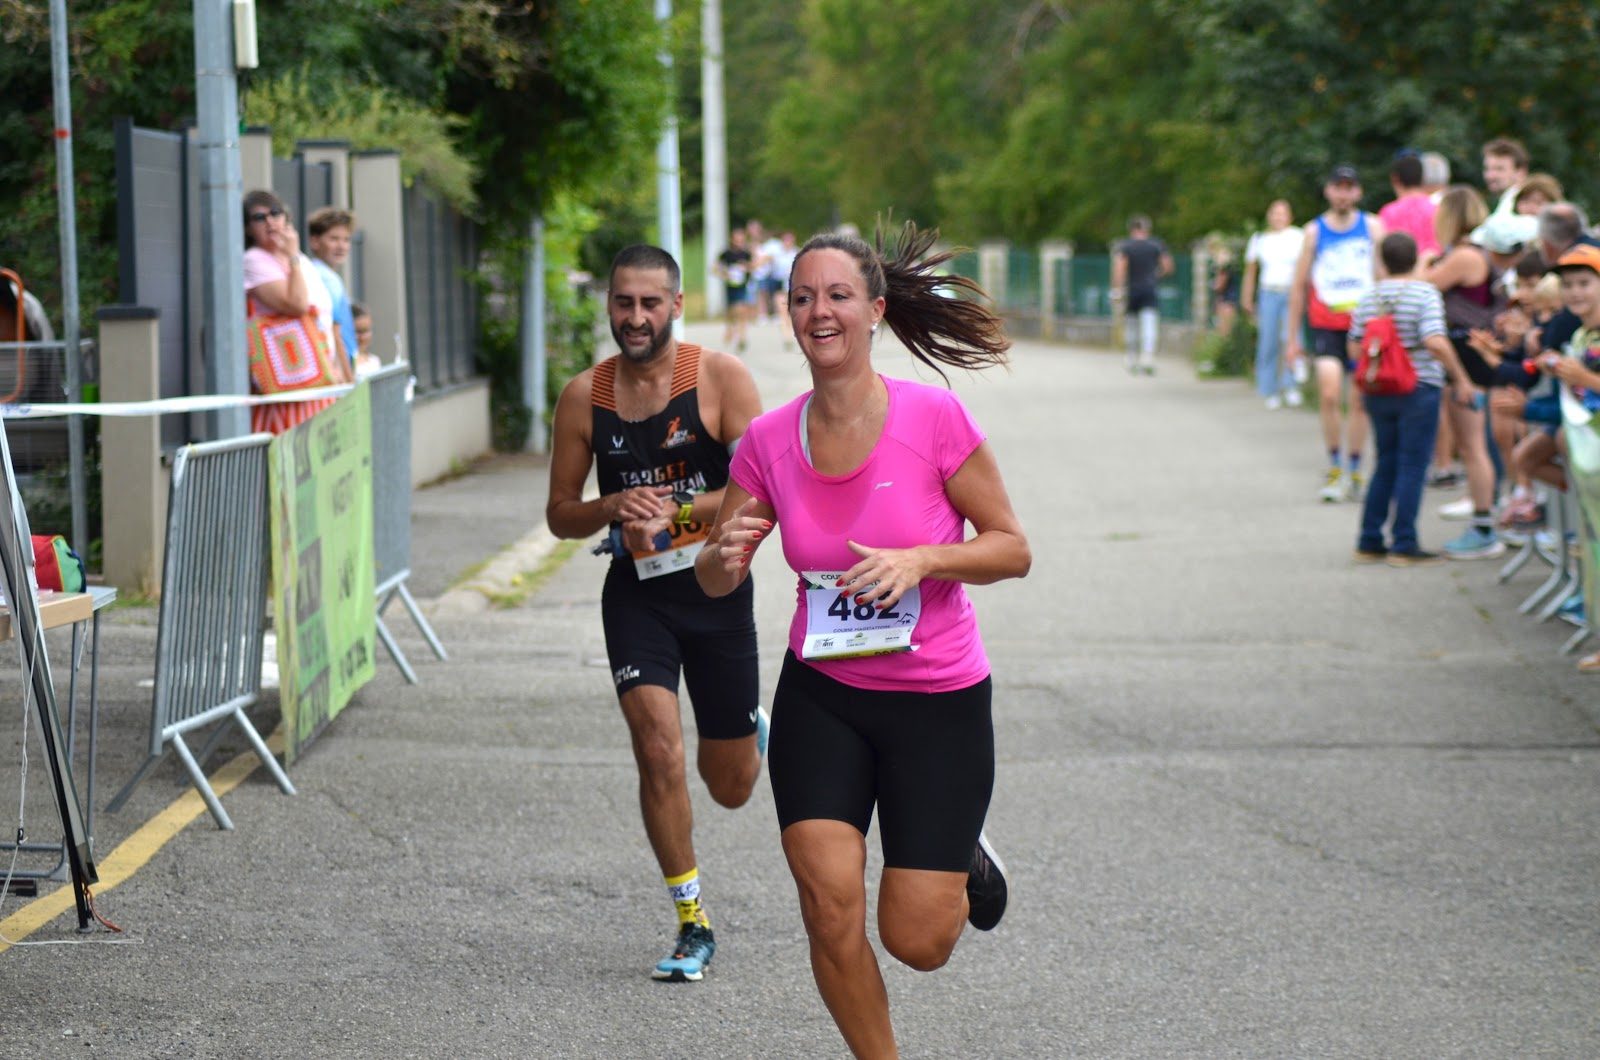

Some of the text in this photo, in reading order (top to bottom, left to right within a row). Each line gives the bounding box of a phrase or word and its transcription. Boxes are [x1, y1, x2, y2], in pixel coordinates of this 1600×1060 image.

[620, 462, 687, 486] TARGET
[673, 470, 708, 493] TEAM
[827, 590, 900, 622] 482
